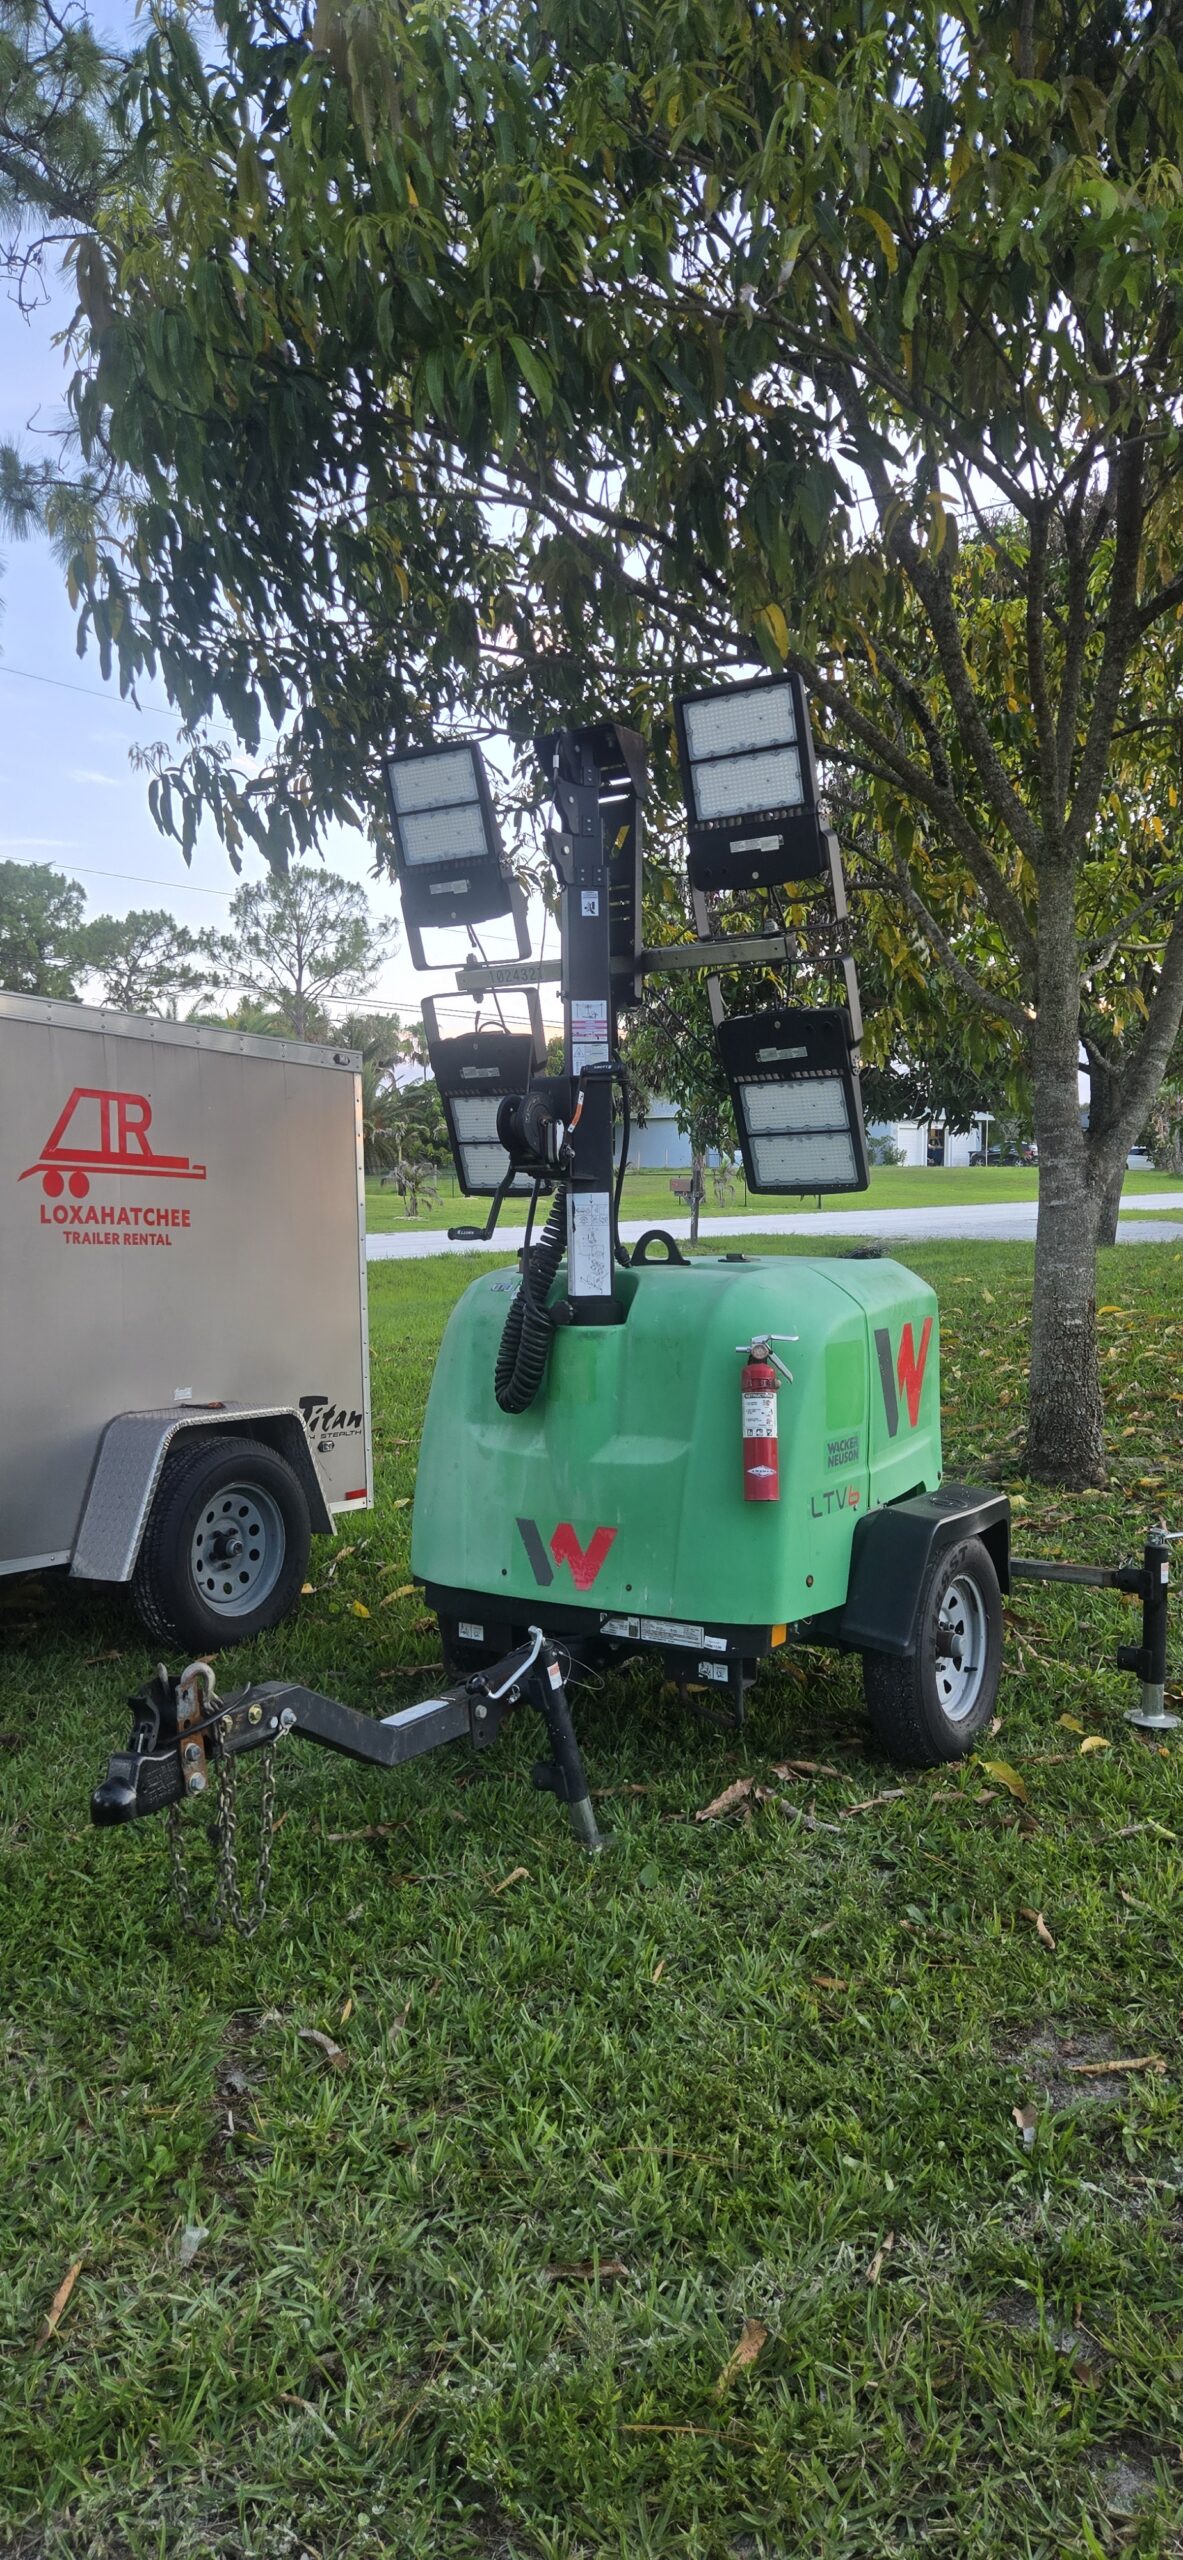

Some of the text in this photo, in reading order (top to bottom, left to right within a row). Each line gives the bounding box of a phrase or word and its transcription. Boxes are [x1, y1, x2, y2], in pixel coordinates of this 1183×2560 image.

[40, 1204, 191, 1227] LOXAHATCHEE
[63, 1231, 172, 1246] TRAILER RENTAL
[299, 1395, 363, 1432] Titan
[321, 1430, 361, 1439] STEALTH
[827, 1436, 859, 1455] WACKER
[827, 1449, 859, 1469] NEUSON
